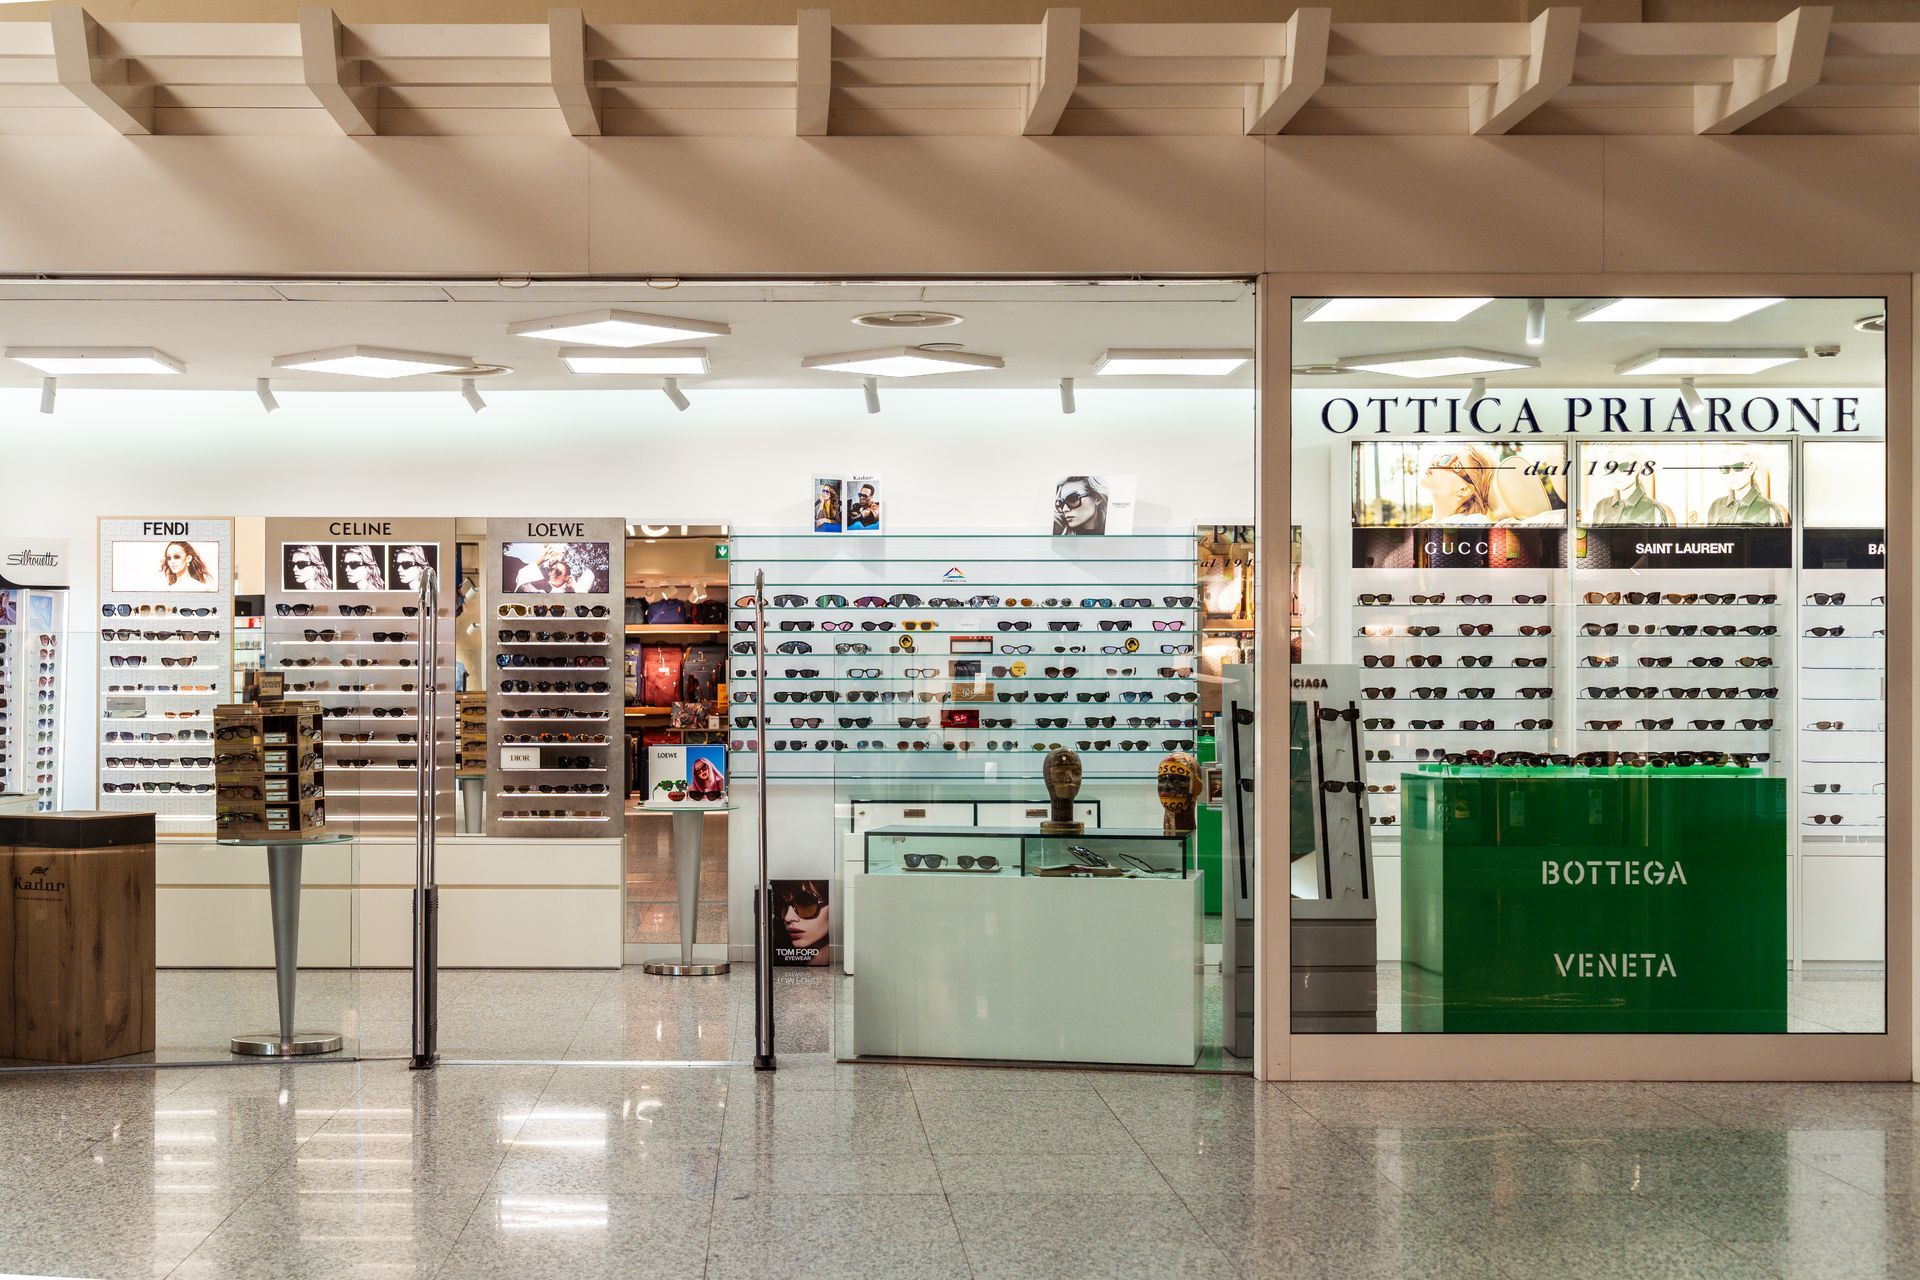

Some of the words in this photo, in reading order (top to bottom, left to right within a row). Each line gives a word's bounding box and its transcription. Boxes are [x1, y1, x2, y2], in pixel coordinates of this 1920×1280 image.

[1321, 397, 1543, 434] OTTICA
[1563, 396, 1860, 433] PRIARONE
[1523, 460, 1572, 476] dal
[1585, 460, 1656, 476] 1948
[143, 521, 189, 536] FENDI
[329, 522, 392, 536] CELINE
[527, 522, 585, 537] LOEWE
[1424, 541, 1499, 555] GUCCI
[1635, 542, 1673, 554] SAINT
[1675, 542, 1735, 554] LAURENT
[6, 549, 58, 567] Silhouette
[1542, 860, 1688, 885] BOTTEGA
[775, 948, 795, 956] TOM
[796, 948, 819, 956] FORD
[1553, 953, 1678, 978] VENETA
